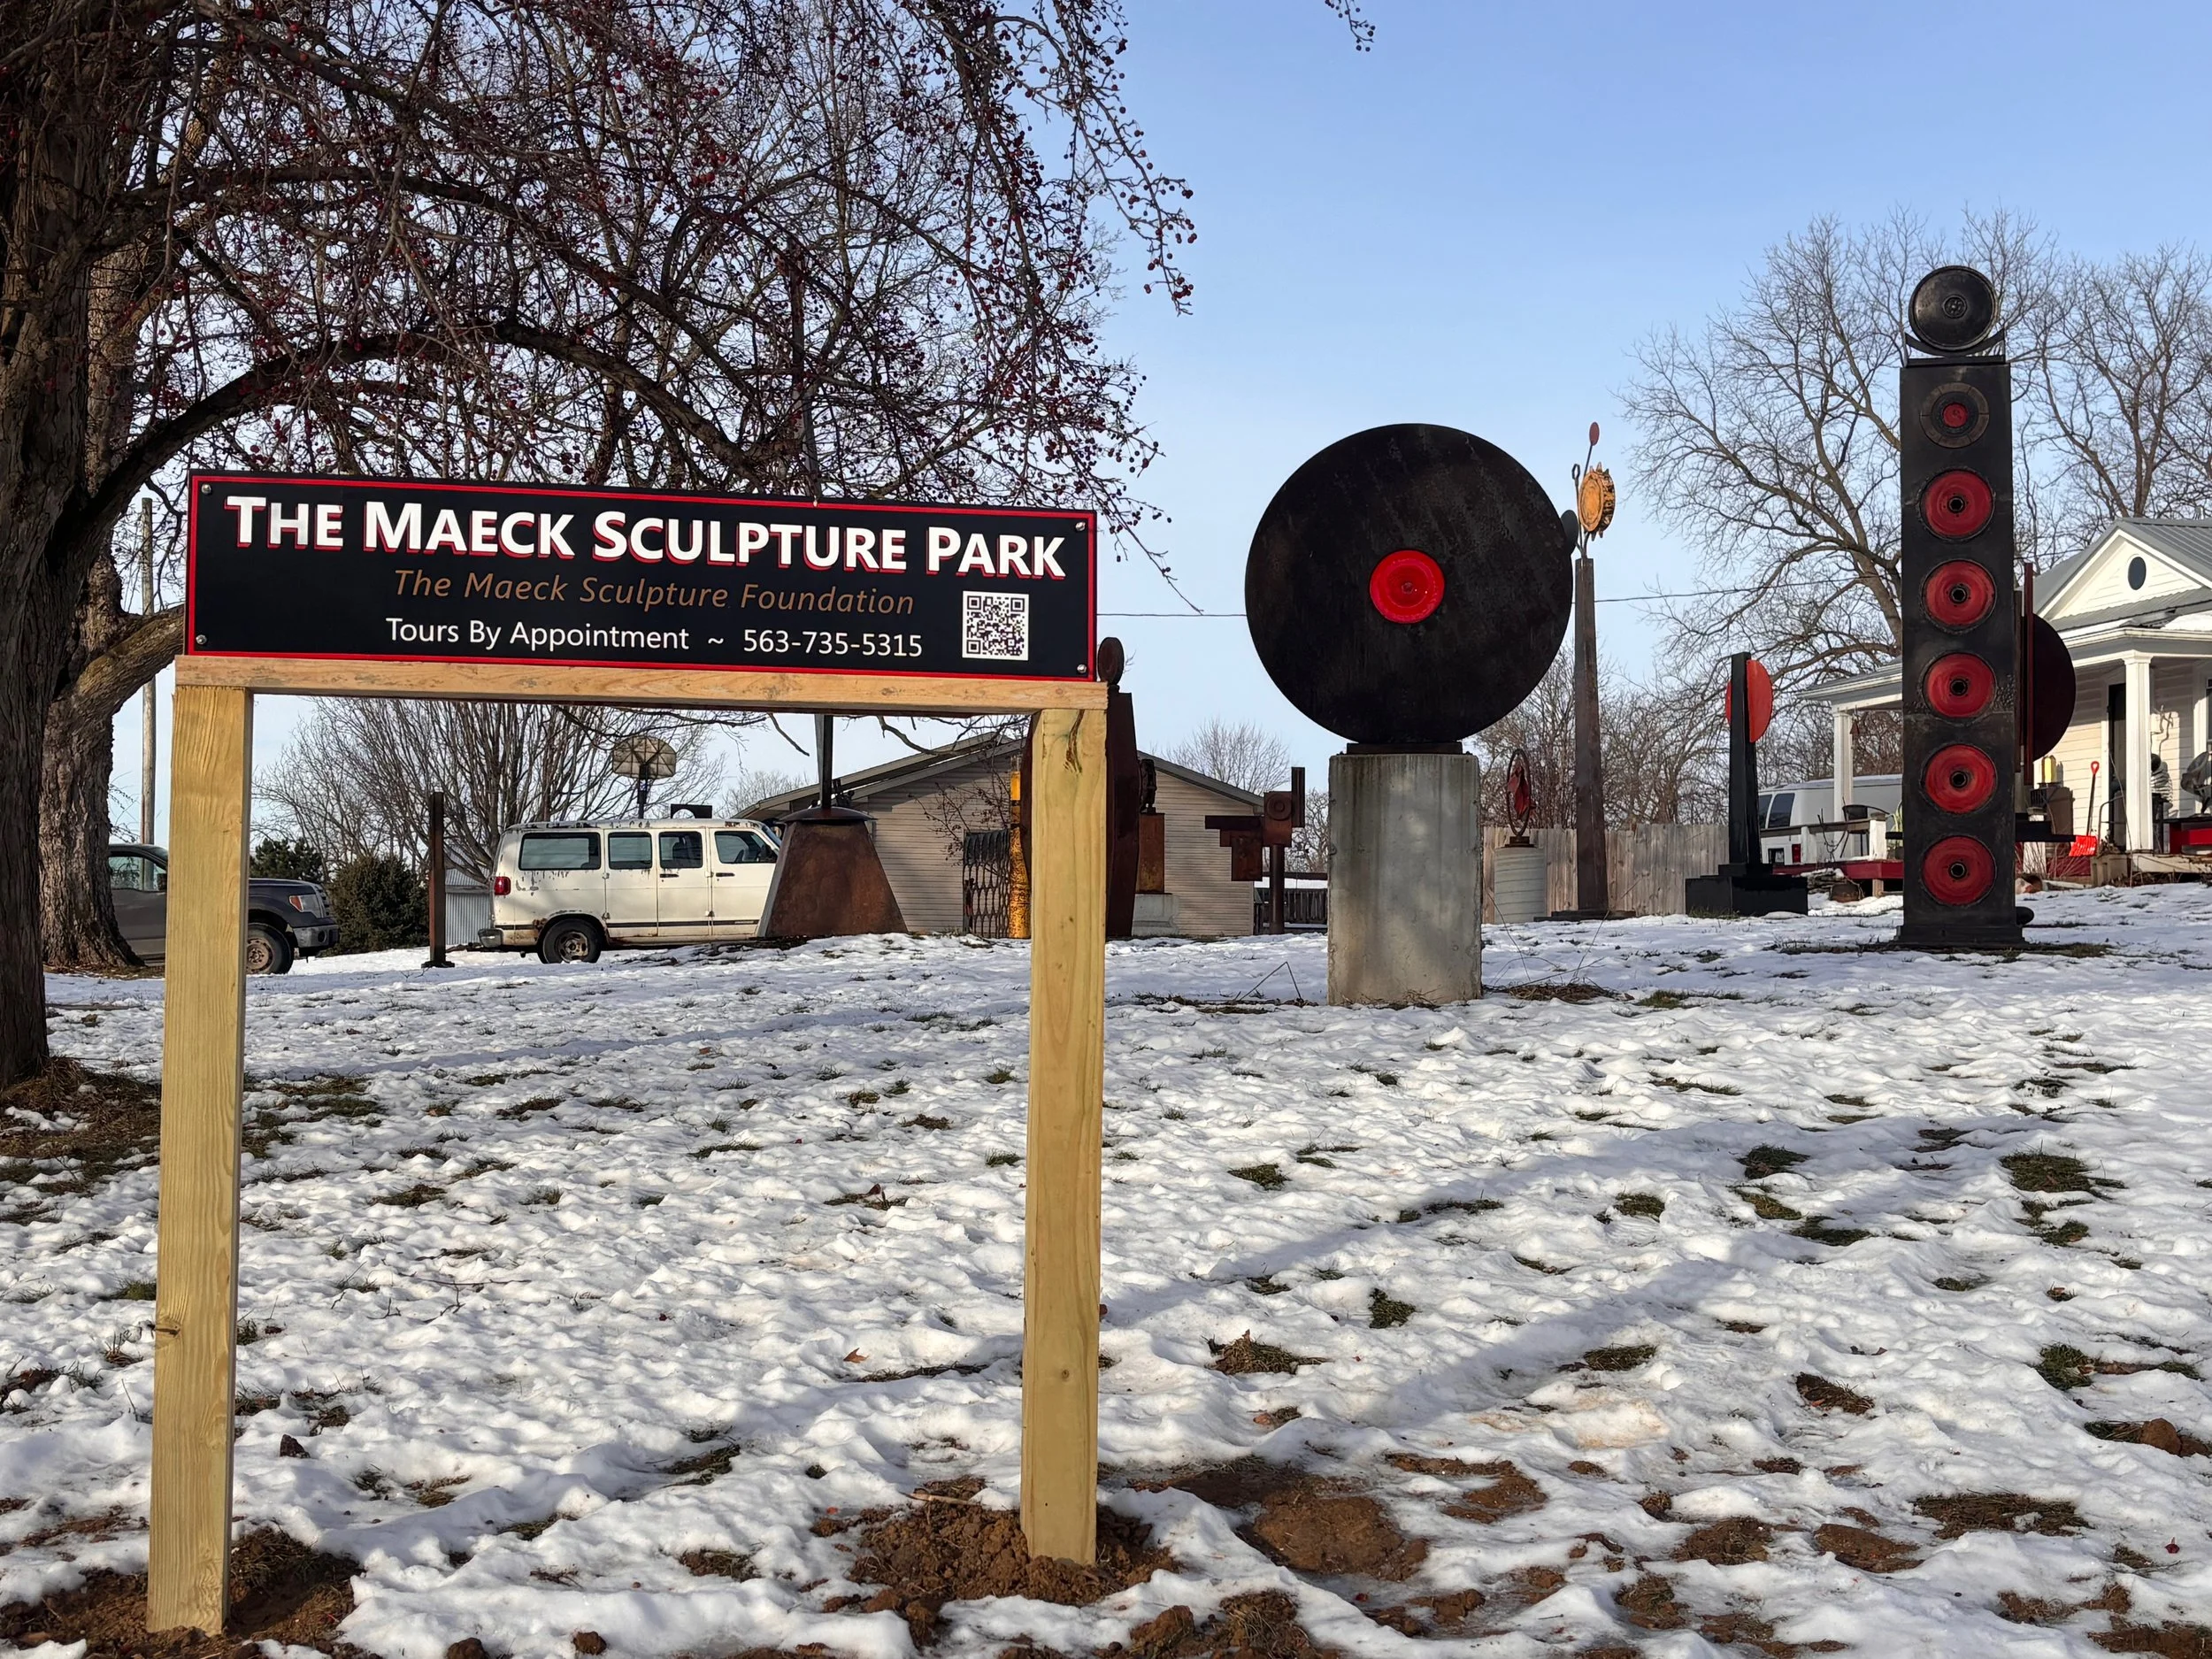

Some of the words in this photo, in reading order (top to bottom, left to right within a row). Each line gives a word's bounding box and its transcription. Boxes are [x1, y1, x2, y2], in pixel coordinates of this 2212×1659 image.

[225, 496, 343, 549] THE
[364, 501, 575, 559] MAECK
[593, 511, 907, 573] SCULPTURE
[926, 526, 1066, 580] PARK
[396, 570, 450, 597] The
[465, 573, 568, 601] Maeck
[580, 577, 727, 611] Sculpture
[741, 585, 914, 614] Foundation
[387, 618, 459, 642] Tours
[471, 620, 502, 649] By
[511, 622, 689, 651] Appointment
[743, 629, 923, 657] 563-735-5315
